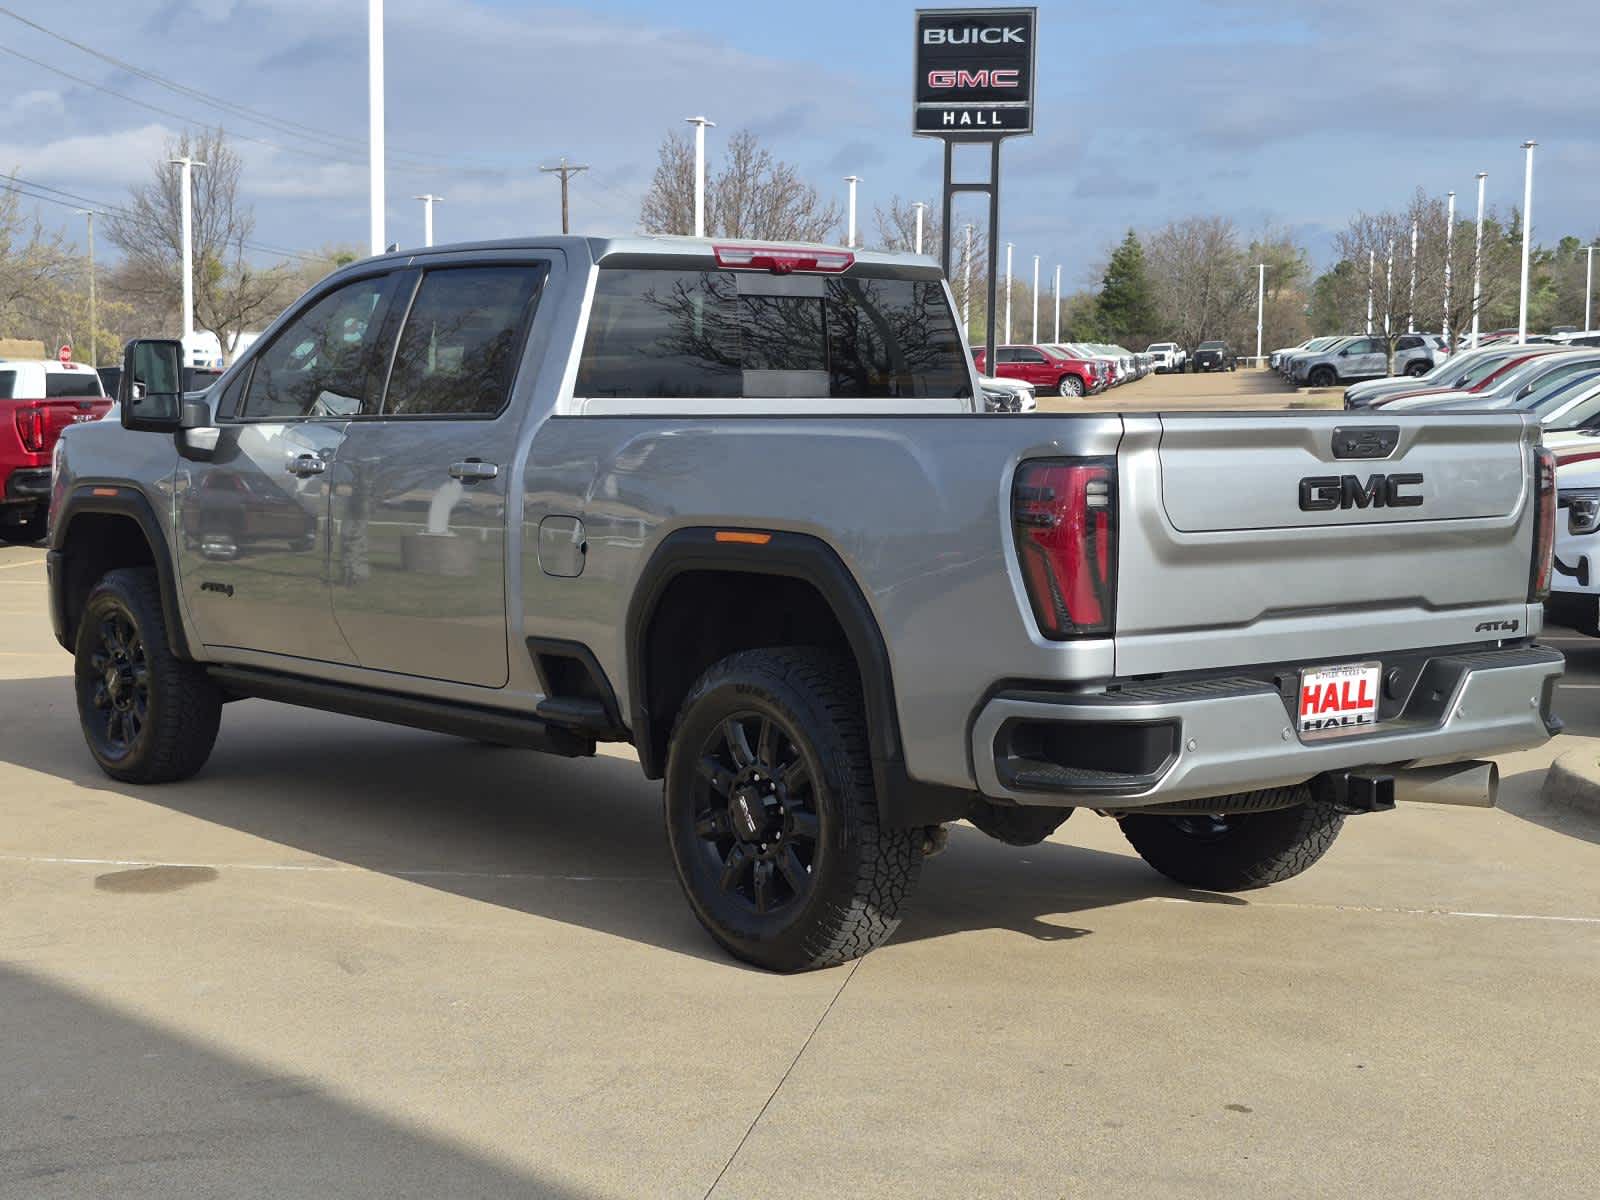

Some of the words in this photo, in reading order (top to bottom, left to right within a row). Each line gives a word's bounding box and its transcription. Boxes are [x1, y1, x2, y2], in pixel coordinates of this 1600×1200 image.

[923, 27, 1025, 44] BUICK
[928, 70, 1019, 88] GMC
[943, 111, 1002, 125] HALL
[1299, 472, 1424, 512] GMC
[1475, 620, 1519, 632] AT4
[1301, 680, 1373, 715] HALL
[1304, 715, 1371, 730] HALL
